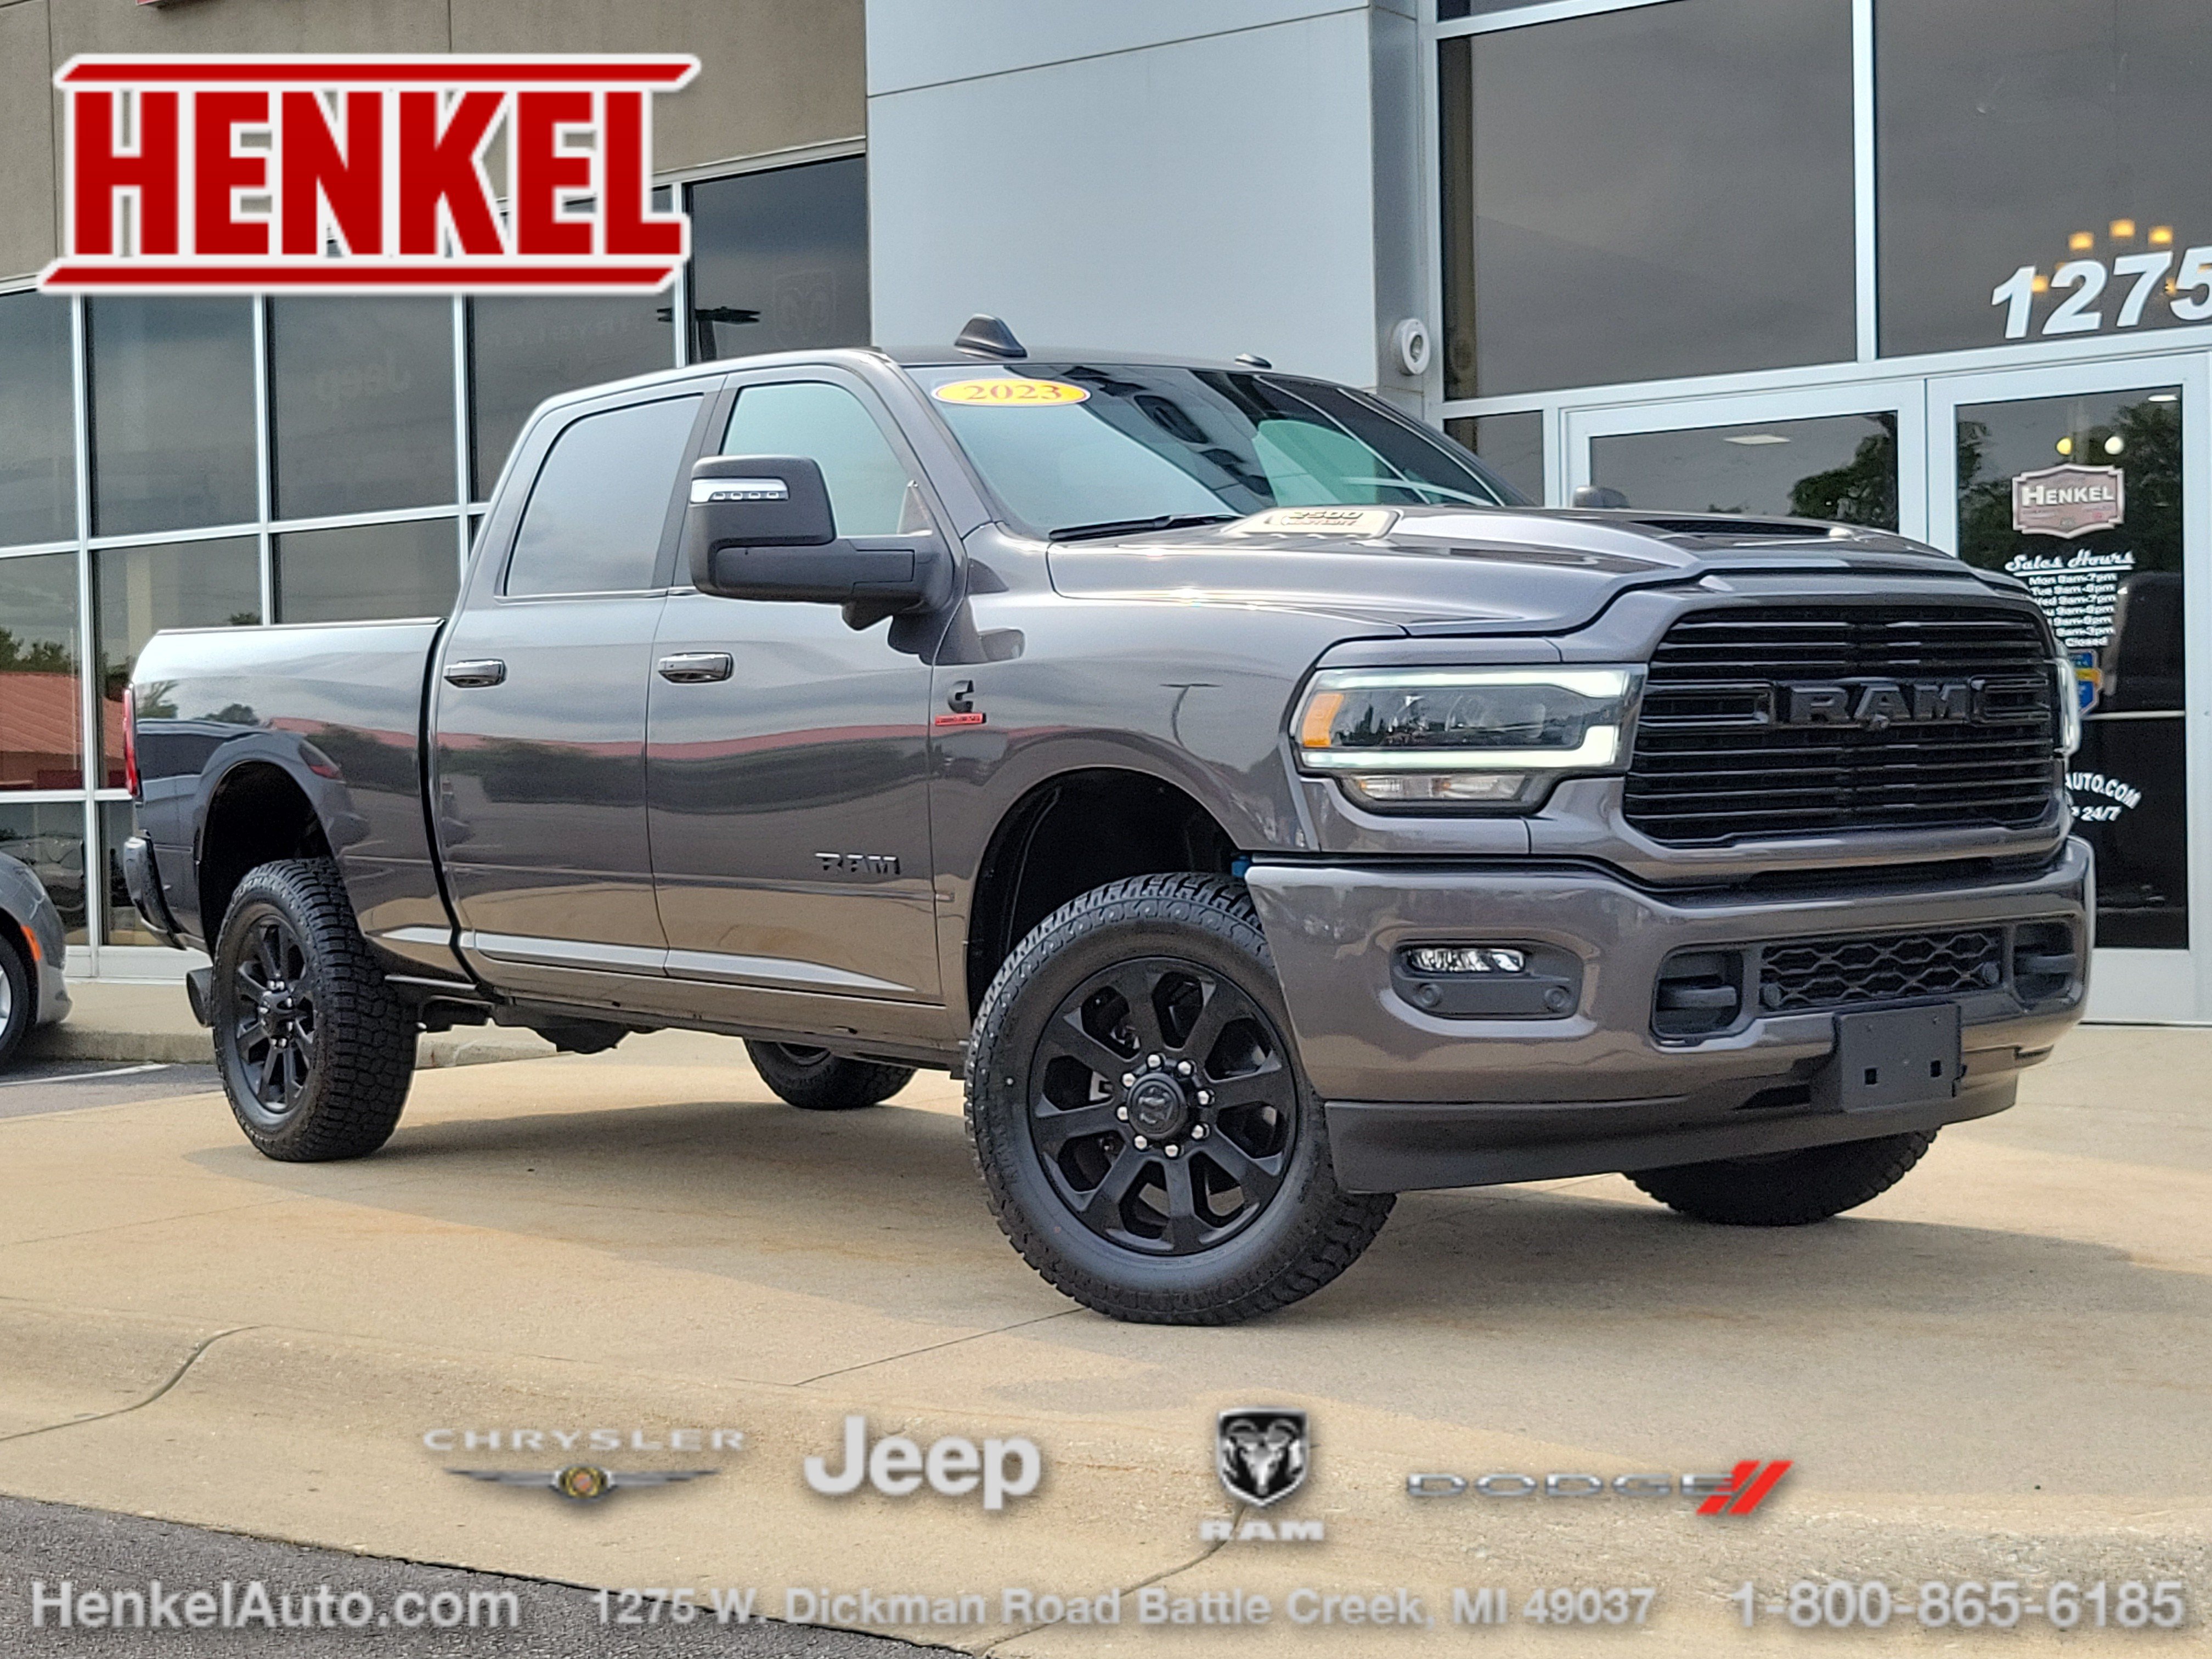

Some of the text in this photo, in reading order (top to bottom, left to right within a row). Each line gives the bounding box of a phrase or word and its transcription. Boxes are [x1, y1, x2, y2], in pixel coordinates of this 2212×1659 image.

[1991, 245, 2212, 339] 1275
[963, 384, 1062, 400] 2023
[2021, 484, 2115, 507] HENKEL
[2005, 549, 2136, 571] Sales Hours
[2029, 576, 2056, 585] Mon
[2065, 637, 2108, 647] Closed
[1790, 683, 1968, 724] RAM
[2080, 805, 2122, 821] 24/7
